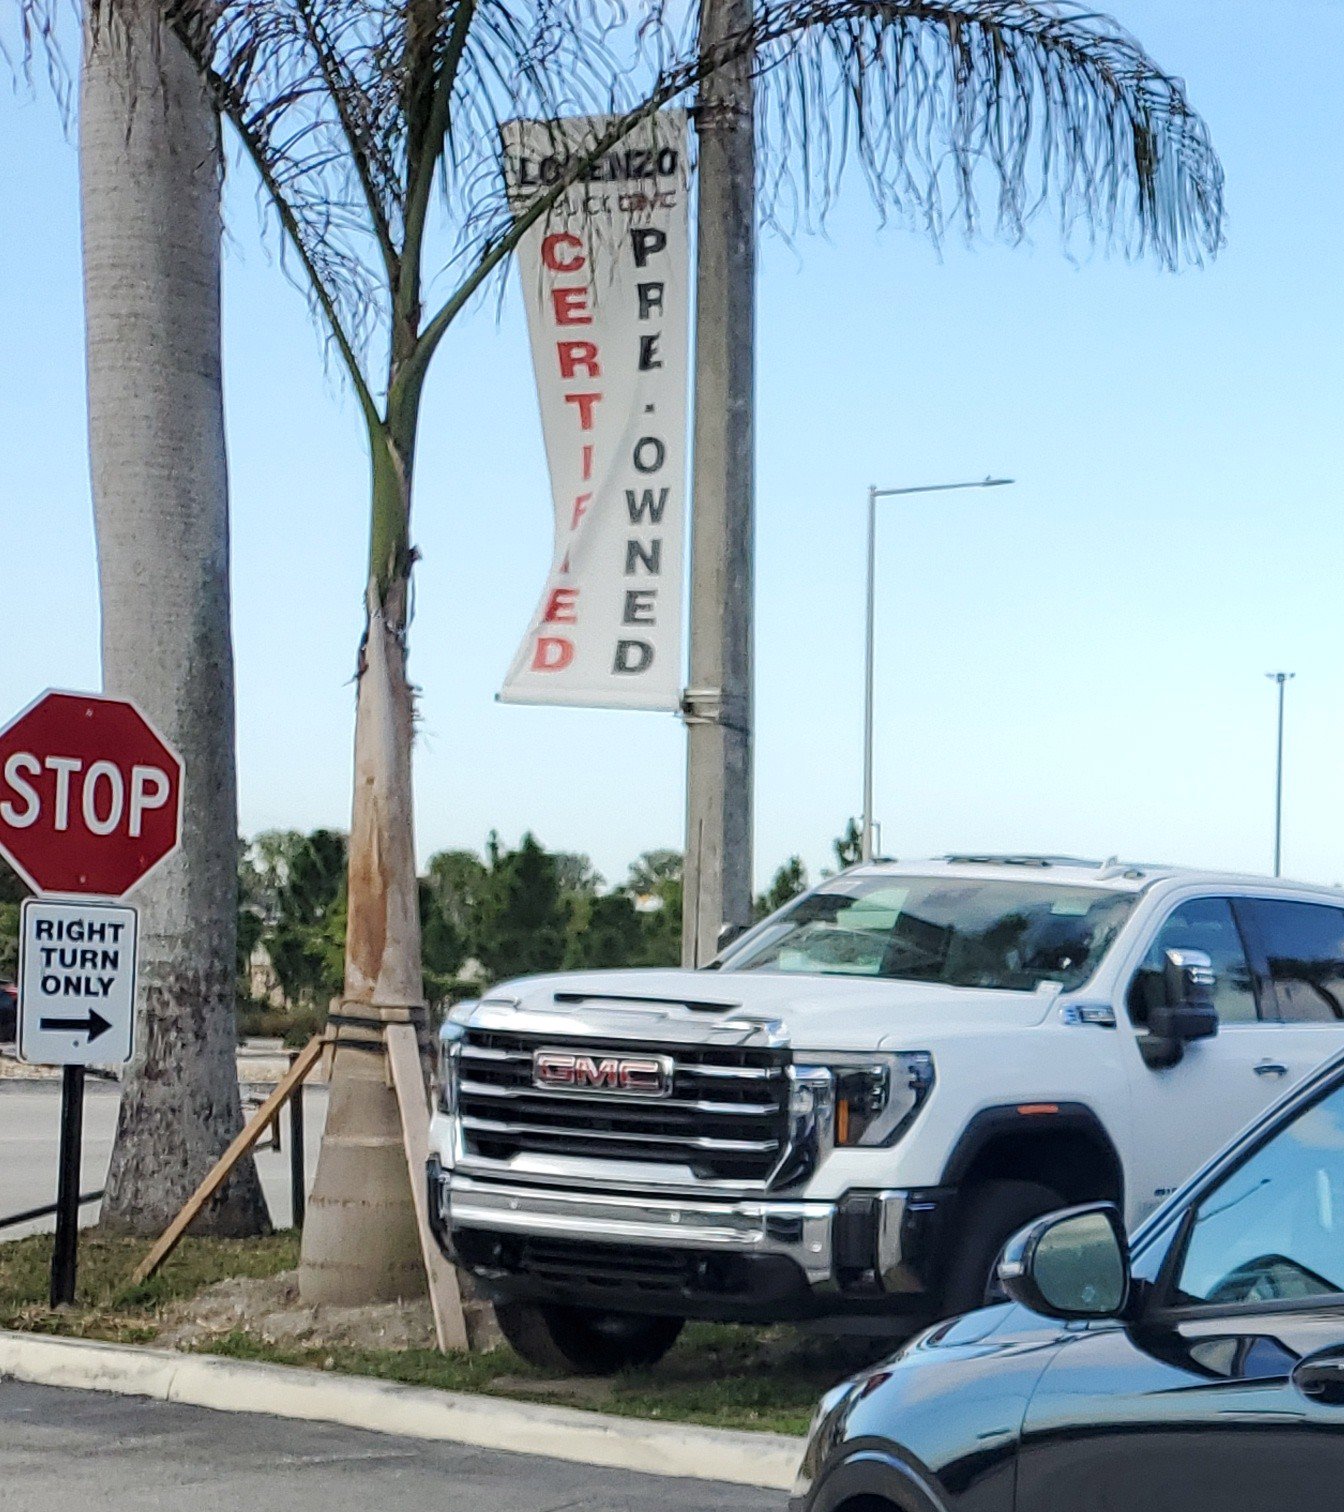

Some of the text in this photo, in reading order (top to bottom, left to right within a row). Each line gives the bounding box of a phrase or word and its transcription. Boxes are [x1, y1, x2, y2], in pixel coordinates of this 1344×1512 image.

[0, 751, 170, 838] STOP
[35, 919, 125, 944] RIGHT
[40, 947, 119, 971] TURN
[41, 975, 115, 997] ONLY
[538, 1054, 660, 1090] GMC
